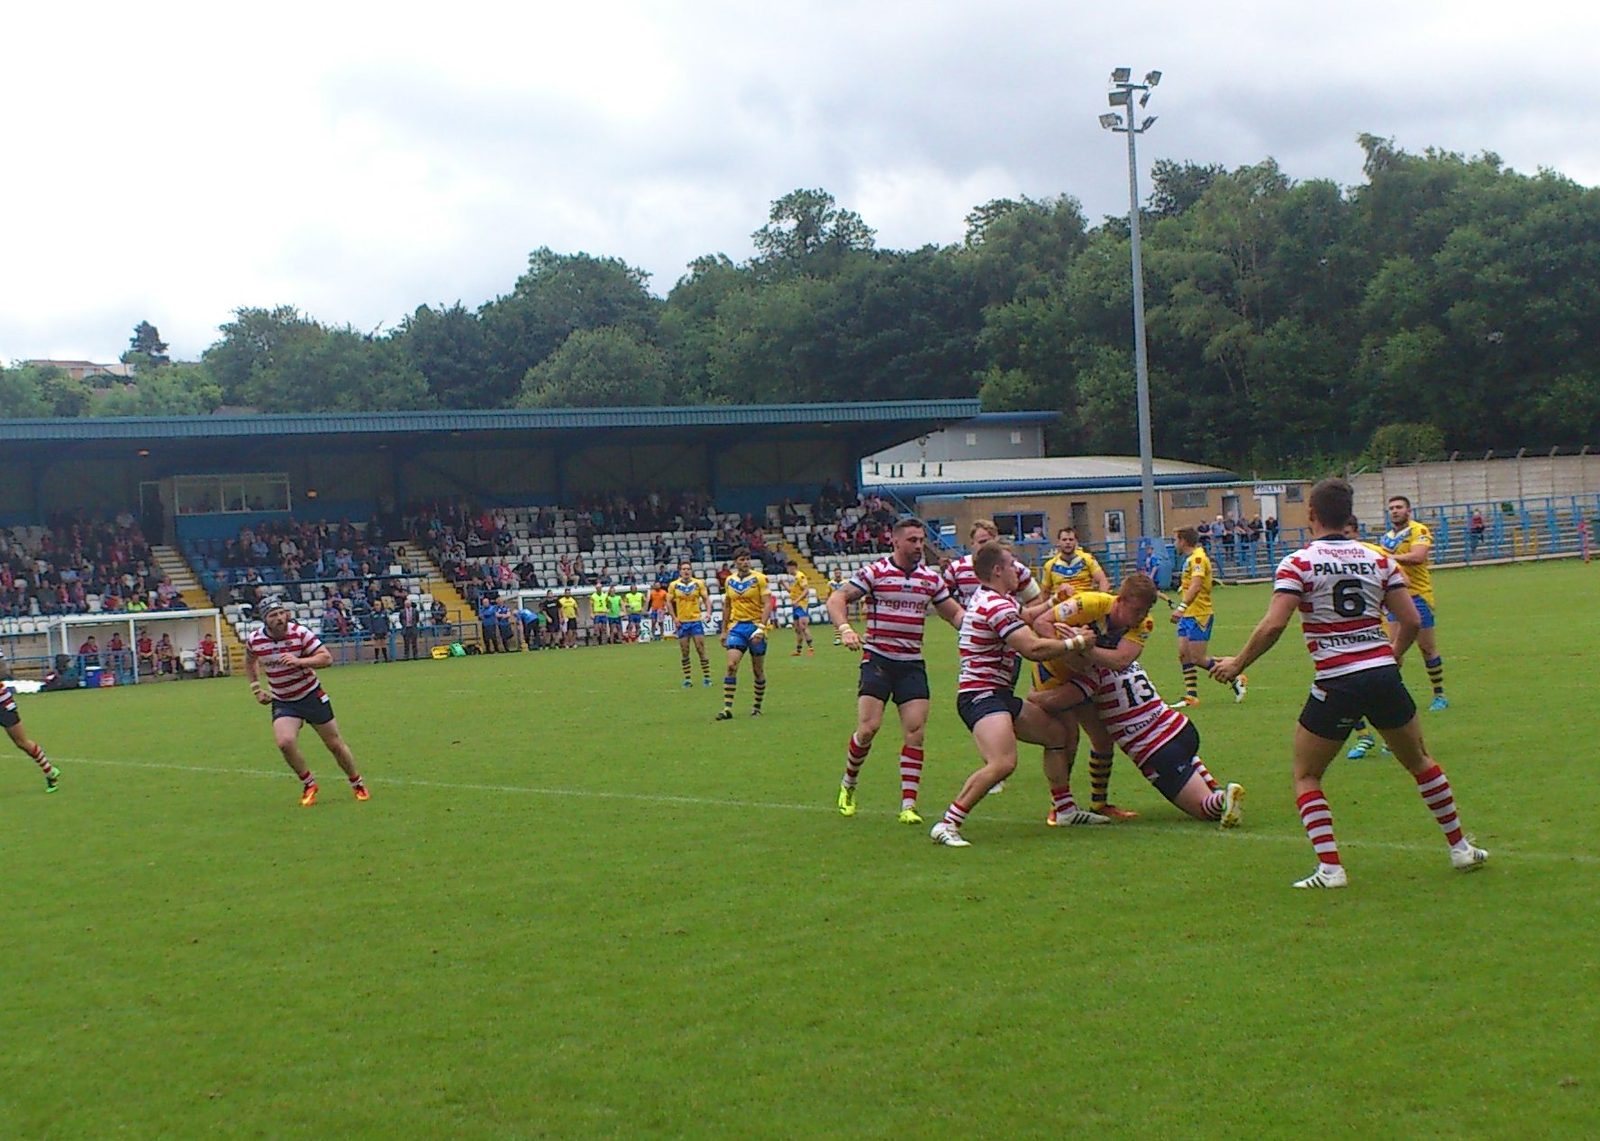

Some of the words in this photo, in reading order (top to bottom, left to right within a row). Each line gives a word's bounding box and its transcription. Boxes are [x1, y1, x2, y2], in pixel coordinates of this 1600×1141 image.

[1313, 562, 1376, 576] PALFREY
[1332, 579, 1367, 617] 6
[1122, 674, 1155, 708] 13
